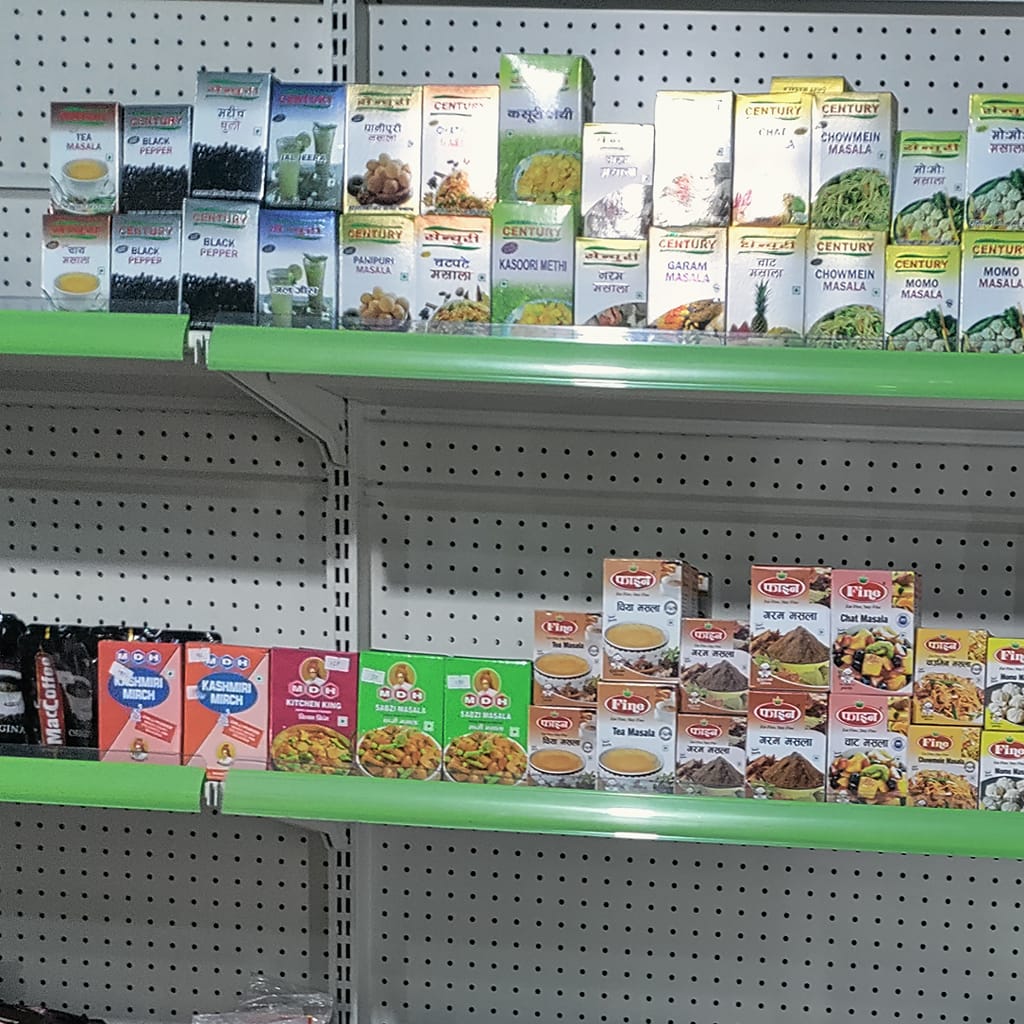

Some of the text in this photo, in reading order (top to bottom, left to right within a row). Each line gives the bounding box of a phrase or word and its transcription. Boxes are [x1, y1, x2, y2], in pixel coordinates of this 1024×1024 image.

[822, 103, 880, 114] CENTURY
[75, 132, 92, 142] TEA
[141, 136, 170, 146] BLACK
[820, 131, 880, 144] CHOWMEIN
[828, 144, 872, 155] MASALA
[192, 212, 249, 224] CENTURY
[348, 229, 403, 240] CENTURY
[502, 226, 562, 238] CENTURY
[203, 237, 236, 248] BLACK
[658, 239, 718, 250] CENTURY
[816, 241, 874, 252] CENTURY
[130, 246, 160, 256] BLACK
[200, 248, 238, 258] PEPPER
[499, 260, 568, 272] KASOORI METHI
[667, 260, 708, 272] GARAM
[894, 260, 950, 270] CENTURY
[814, 268, 876, 280] CHOWMEIN
[984, 266, 1020, 278] MOMO
[822, 281, 867, 292] MASALA
[905, 278, 940, 289] MOMO
[978, 278, 1024, 289] MASALA
[900, 289, 944, 300] MASALA
[840, 614, 888, 624] Chat Masala
[118, 652, 160, 664] MDH
[206, 656, 248, 668] MDH
[201, 680, 252, 692] KASHMIRI
[290, 684, 336, 697] MDH
[122, 689, 156, 700] MIRCH
[210, 693, 244, 706] MIRCH
[379, 688, 424, 700] MDH
[464, 694, 510, 707] MDH
[612, 727, 656, 738] Tea Masala
